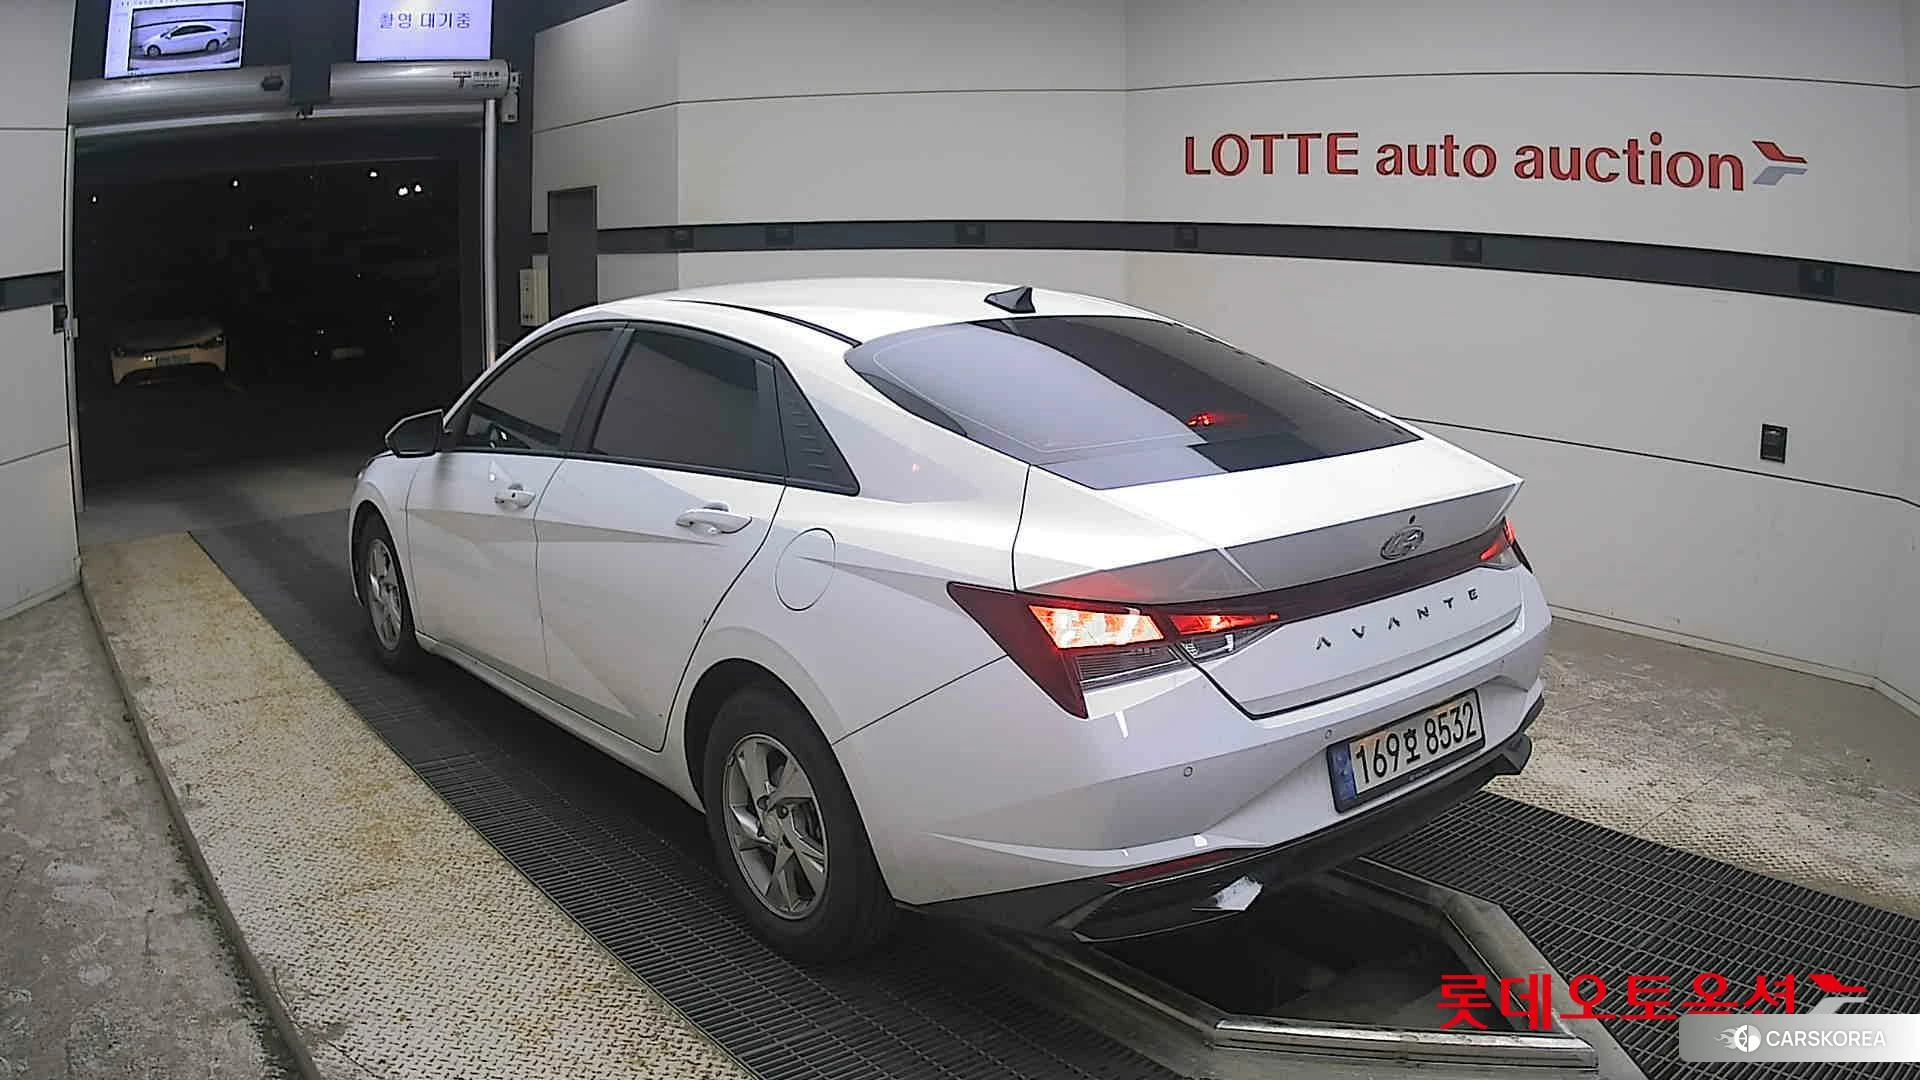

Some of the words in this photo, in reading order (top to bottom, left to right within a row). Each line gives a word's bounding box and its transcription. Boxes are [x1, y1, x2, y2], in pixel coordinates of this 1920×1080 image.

[420, 12, 471, 29] 대기중
[1185, 132, 1359, 176] LOTTE
[1376, 135, 1497, 178] auto
[1513, 132, 1744, 191] auction
[1315, 588, 1479, 651] AVANTE
[1355, 727, 1421, 785] 169호
[1424, 700, 1477, 755] 8532
